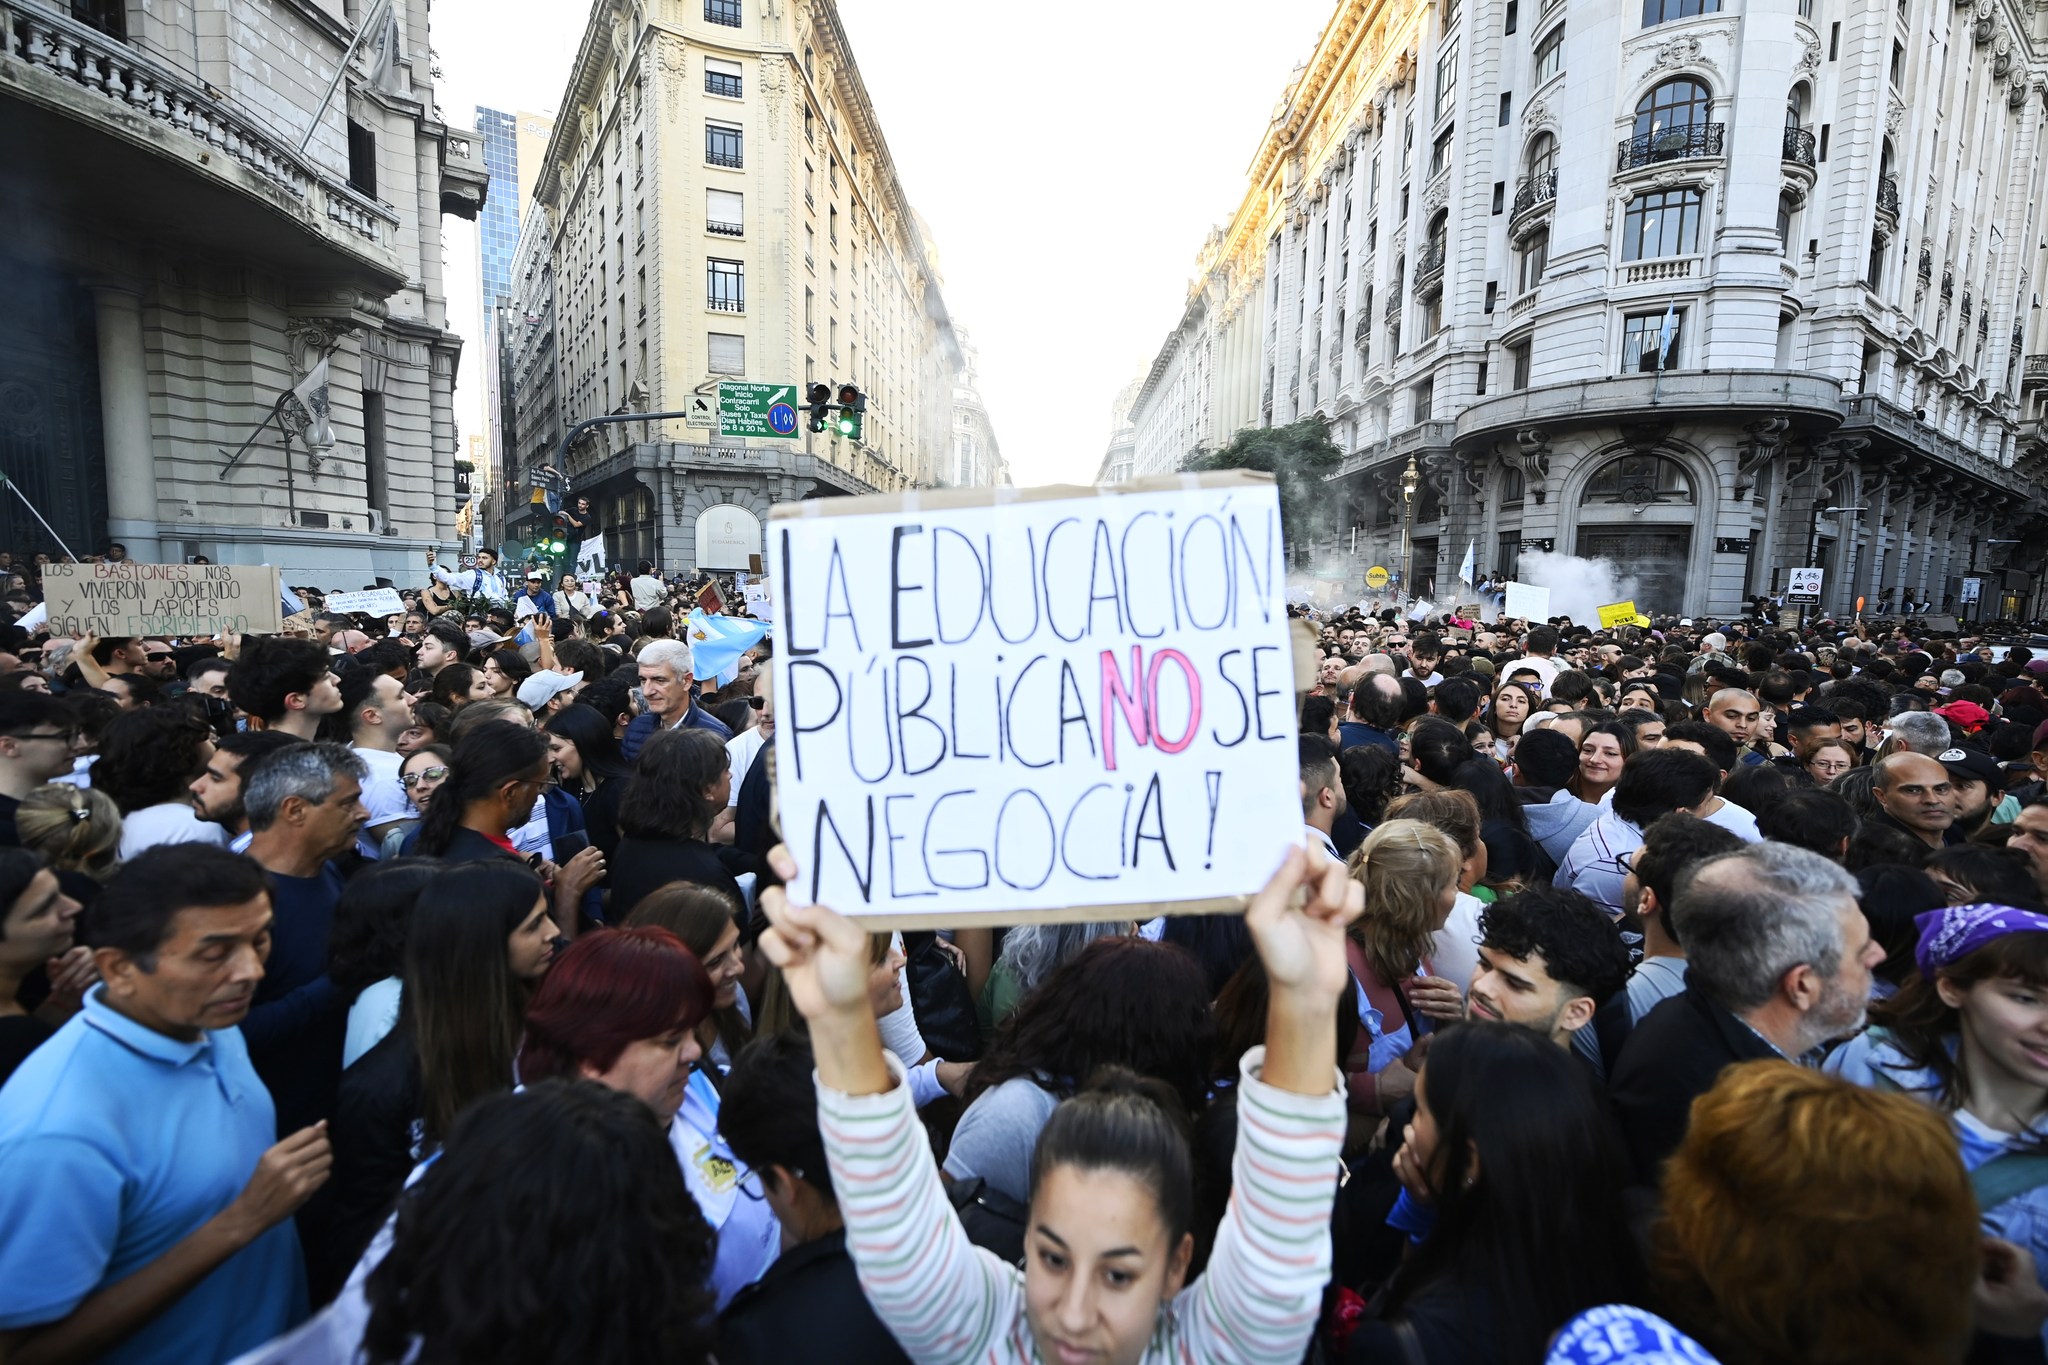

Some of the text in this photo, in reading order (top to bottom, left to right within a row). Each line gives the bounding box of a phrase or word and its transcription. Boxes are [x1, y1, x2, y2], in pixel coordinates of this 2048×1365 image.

[720, 383, 749, 391] Diagonal
[720, 397, 759, 405] Contracarril
[44, 563, 232, 581] LOS BASTONES NOS
[782, 528, 863, 656] LA
[61, 600, 74, 613] Y
[92, 600, 120, 616] LOS
[1099, 644, 1202, 771] NO
[1212, 646, 1287, 747] SE
